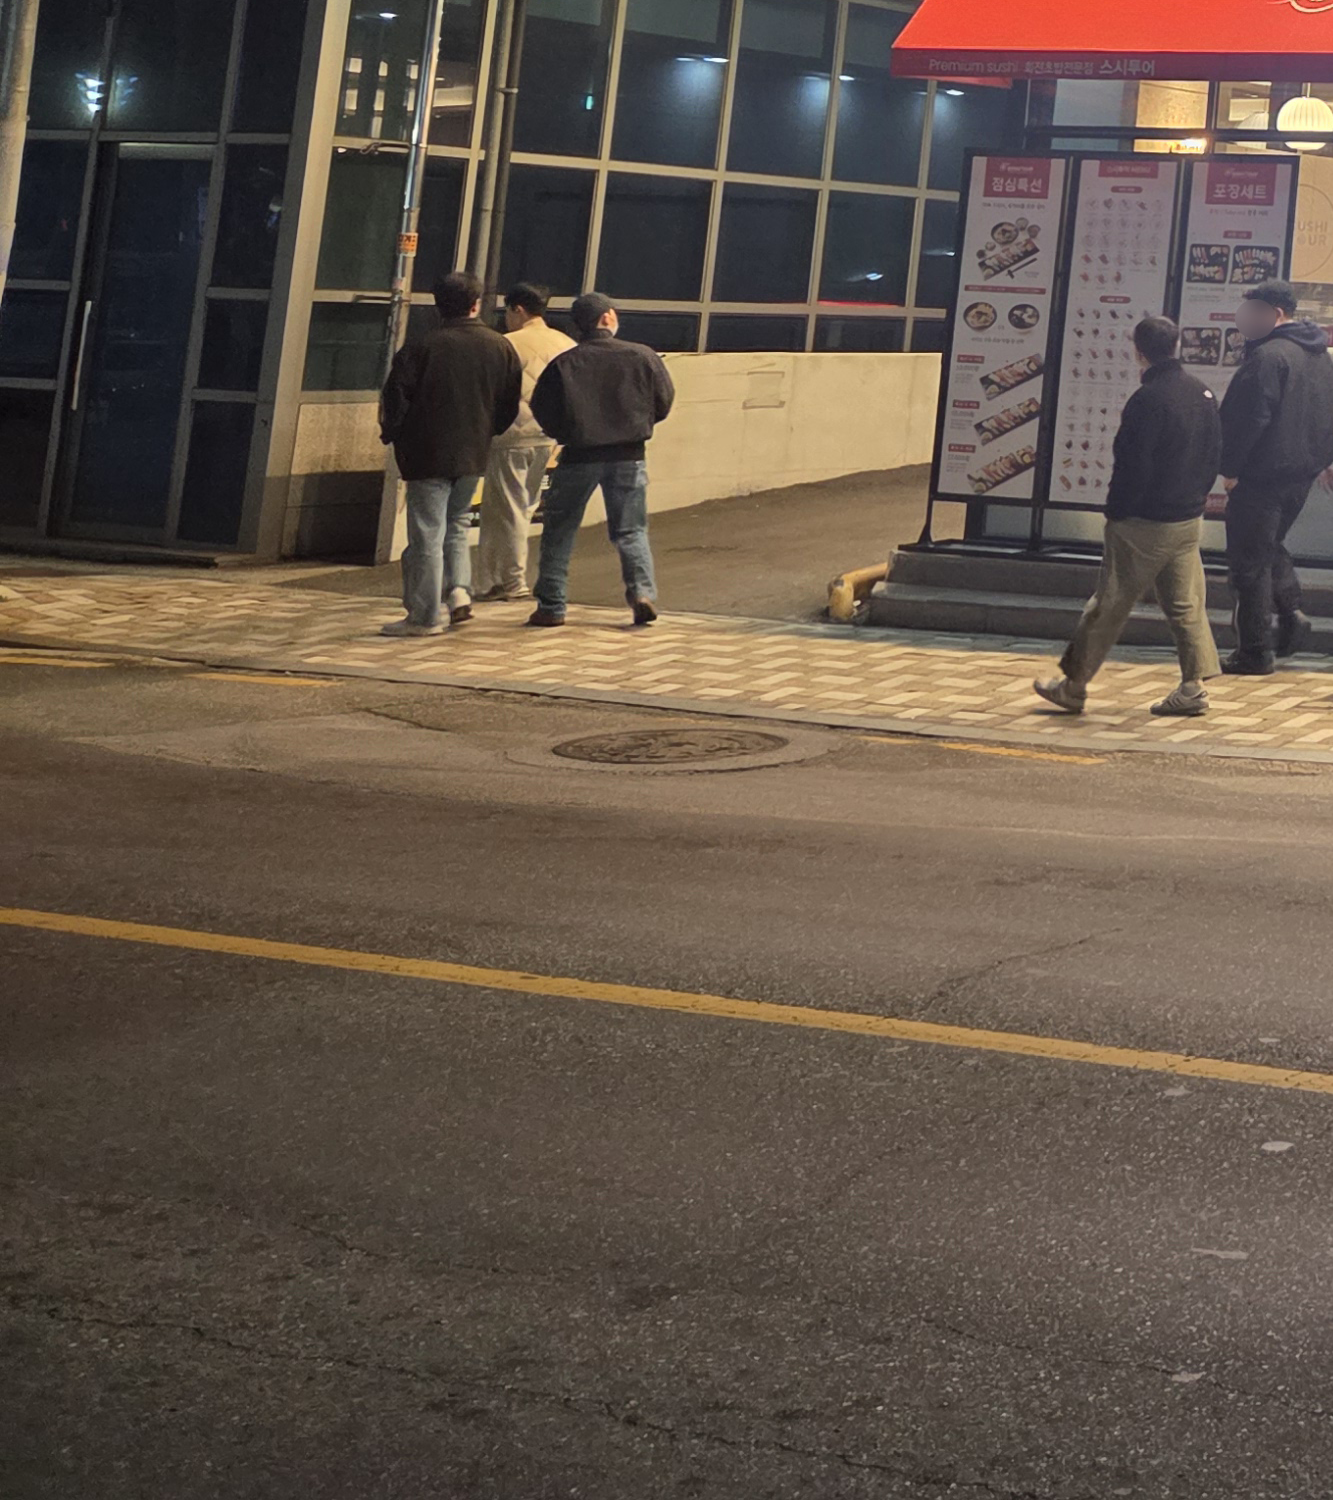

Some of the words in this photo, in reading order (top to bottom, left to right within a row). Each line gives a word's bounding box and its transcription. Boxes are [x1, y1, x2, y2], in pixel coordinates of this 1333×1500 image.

[928, 59, 983, 73] Premium
[987, 59, 1018, 73] sushi
[1099, 59, 1155, 76] 스시투어
[1213, 184, 1267, 200] 포장세트
[1297, 220, 1328, 233] USHI
